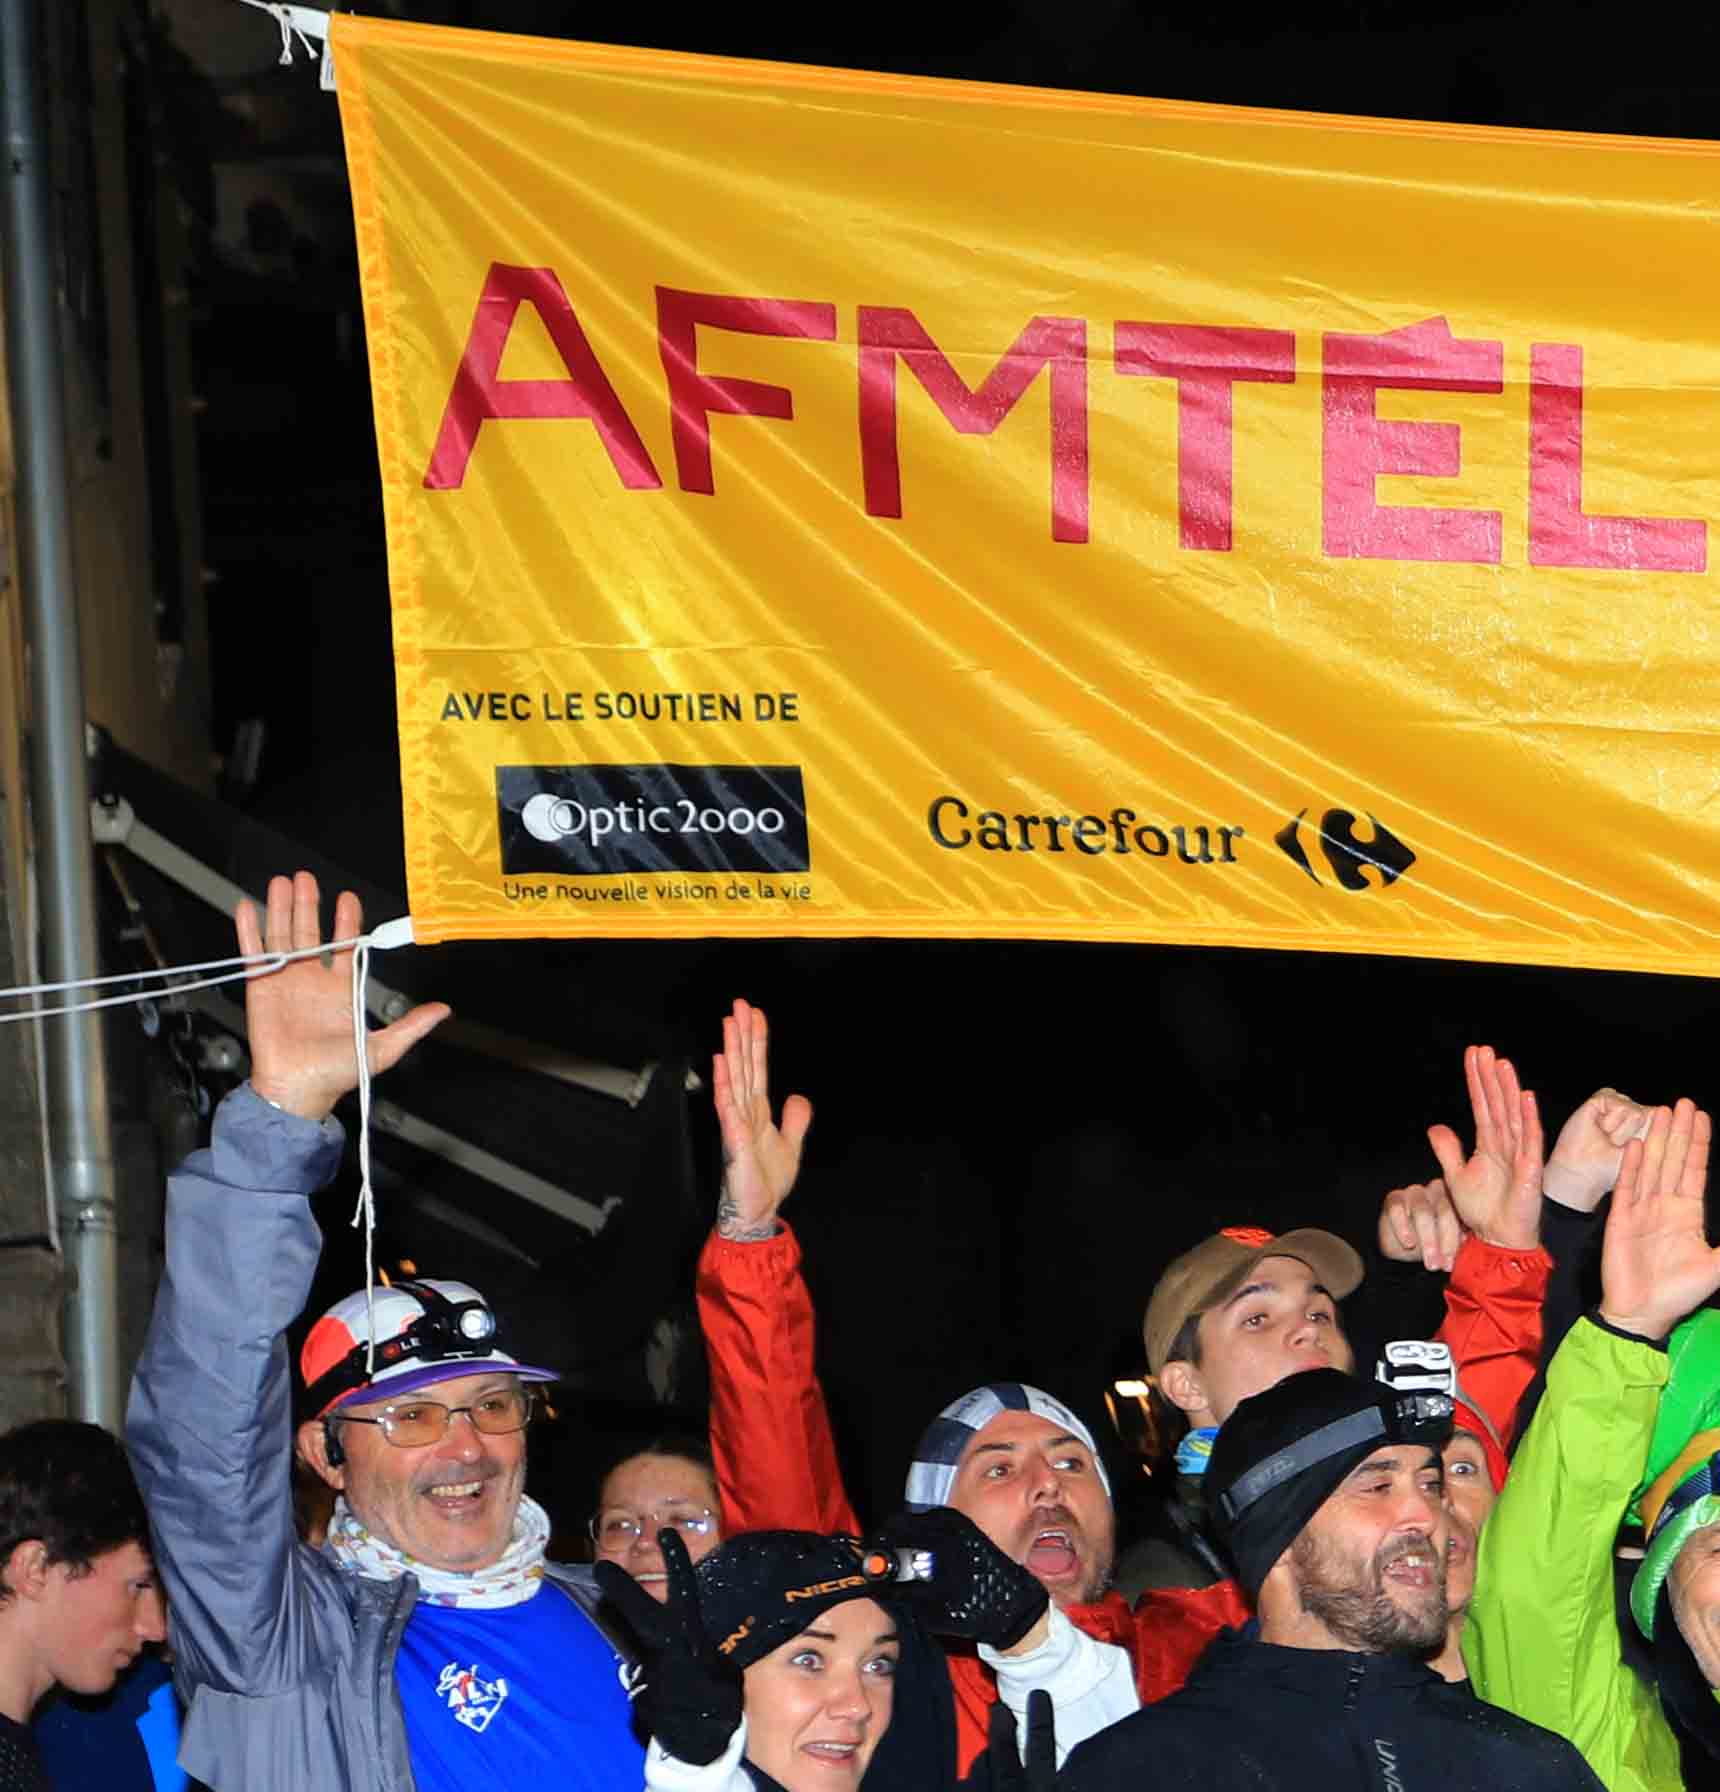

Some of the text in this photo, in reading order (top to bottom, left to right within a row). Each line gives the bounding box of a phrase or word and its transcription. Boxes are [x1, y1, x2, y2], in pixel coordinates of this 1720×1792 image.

[441, 693, 800, 721] AVEC LE SOUTIEN DE
[927, 796, 1244, 864] Carrefour
[504, 879, 811, 901] Une nouvelle vision de la vie
